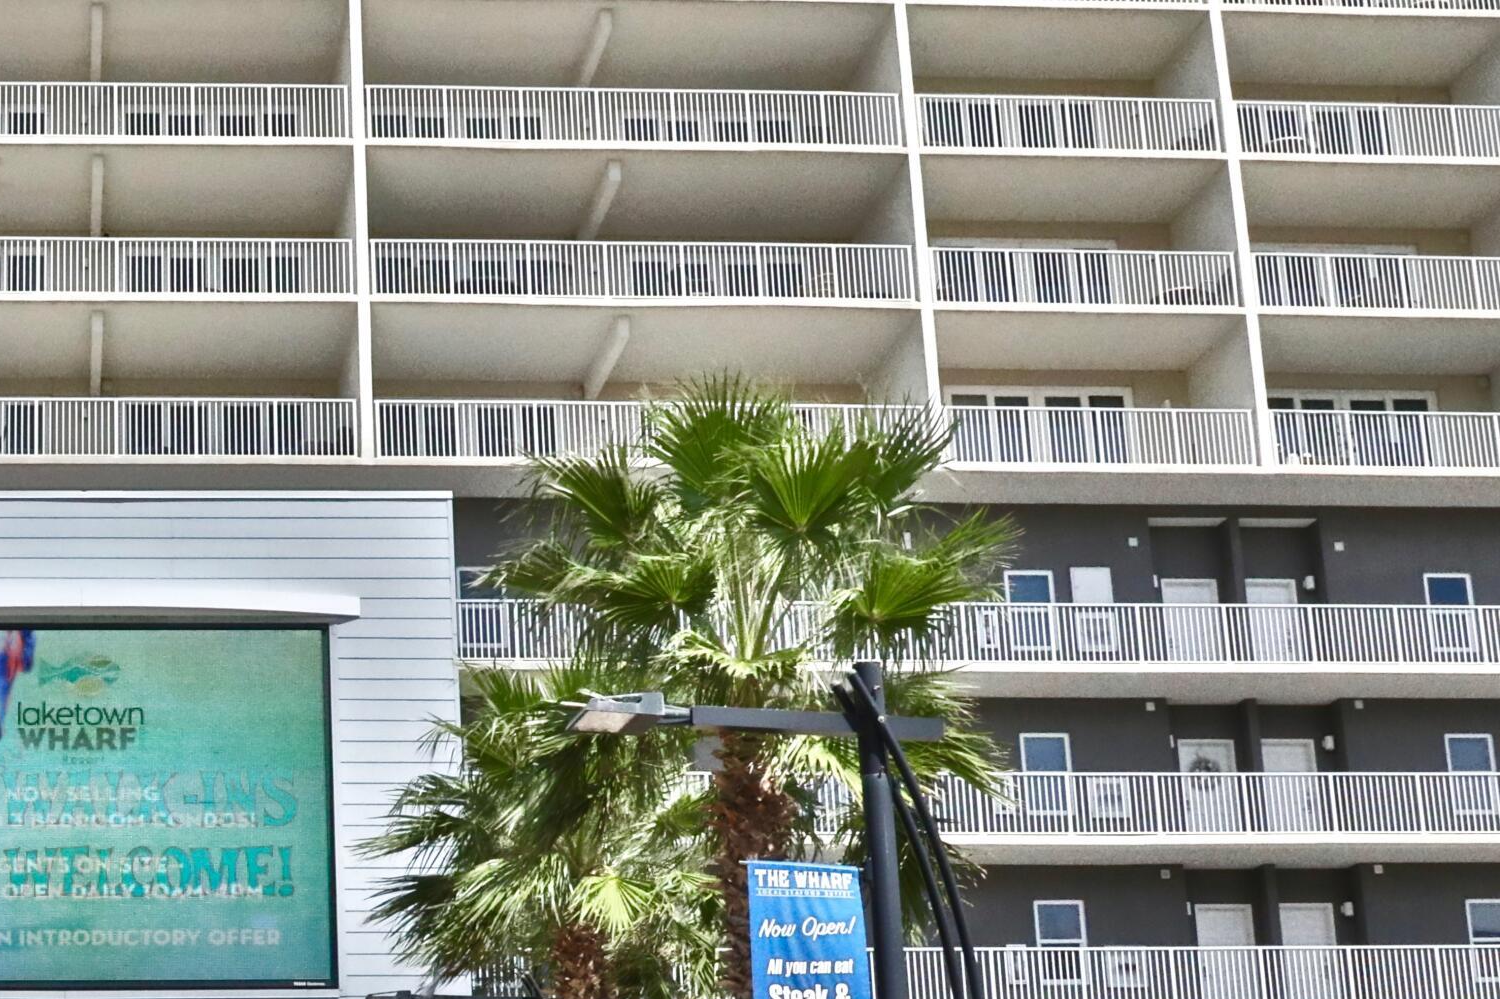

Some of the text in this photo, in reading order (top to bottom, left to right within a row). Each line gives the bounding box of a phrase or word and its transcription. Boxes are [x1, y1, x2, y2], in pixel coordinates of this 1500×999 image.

[17, 701, 145, 726] laketown
[17, 727, 138, 751] WHARF
[5, 786, 160, 802] NOW SELLING
[73, 856, 110, 874] ON
[754, 868, 853, 890] THE WHARF
[3, 883, 65, 900] OPEN
[72, 883, 135, 900] DAILY
[19, 930, 202, 946] INTRODUCTORY
[207, 930, 281, 946] OFFER
[758, 915, 857, 941] Now Open!
[767, 958, 854, 978] All you can eat
